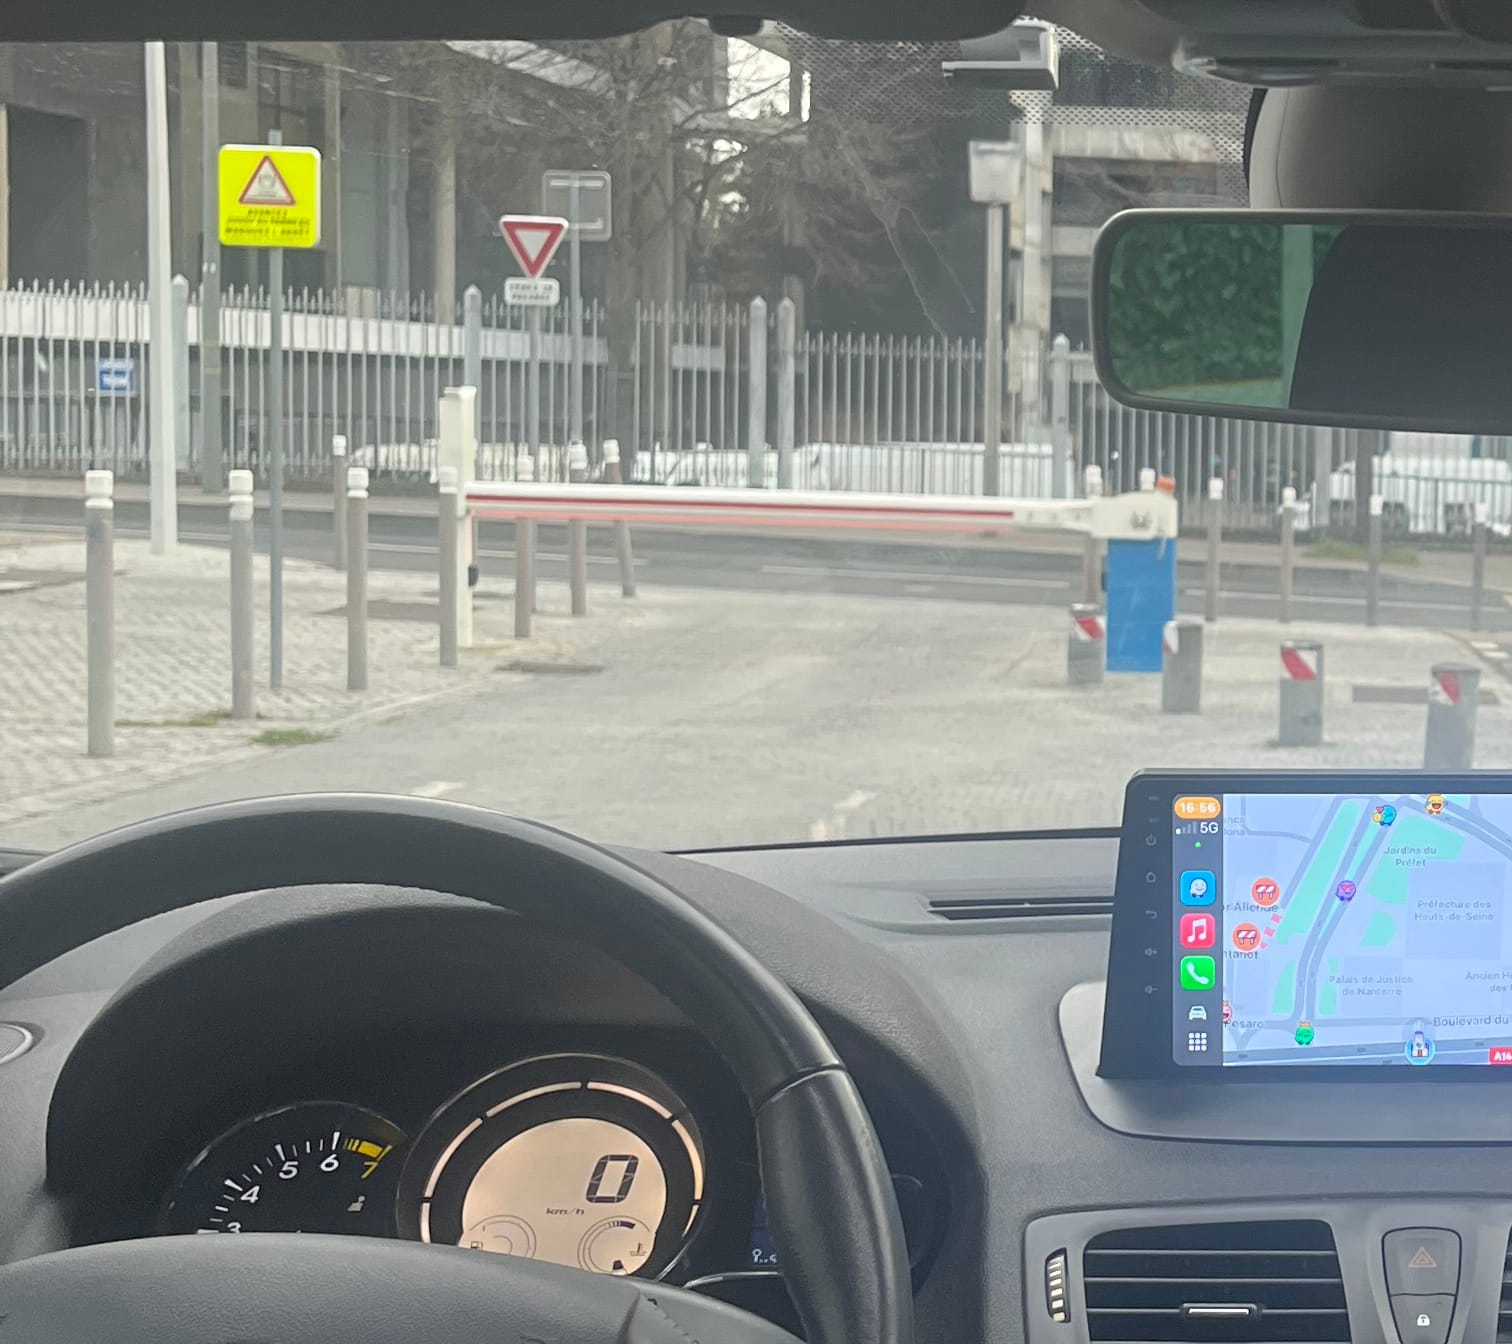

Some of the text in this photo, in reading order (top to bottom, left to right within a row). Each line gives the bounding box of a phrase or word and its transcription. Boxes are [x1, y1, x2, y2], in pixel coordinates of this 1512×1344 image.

[1180, 803, 1216, 813] 16:56
[1200, 822, 1219, 834] 5G
[1384, 846, 1437, 855] Jardins du
[1395, 858, 1426, 868] Préfet
[1417, 899, 1491, 909] Préfecture des
[1414, 912, 1494, 921] Hauts-de-Seine
[1329, 975, 1413, 984] Palais de Justice
[1466, 971, 1500, 980] Ancien
[1342, 988, 1401, 996] de Nanterre
[1489, 984, 1507, 992] des
[1433, 1014, 1491, 1027] Boulevard
[1494, 1014, 1509, 1025] du
[1493, 1051, 1512, 1061] A14
[320, 1154, 339, 1171] 6
[279, 1161, 298, 1179] 5
[361, 1161, 378, 1179] 7
[585, 1154, 639, 1203] 0
[240, 1185, 260, 1203] 4
[545, 1207, 585, 1215] km/h
